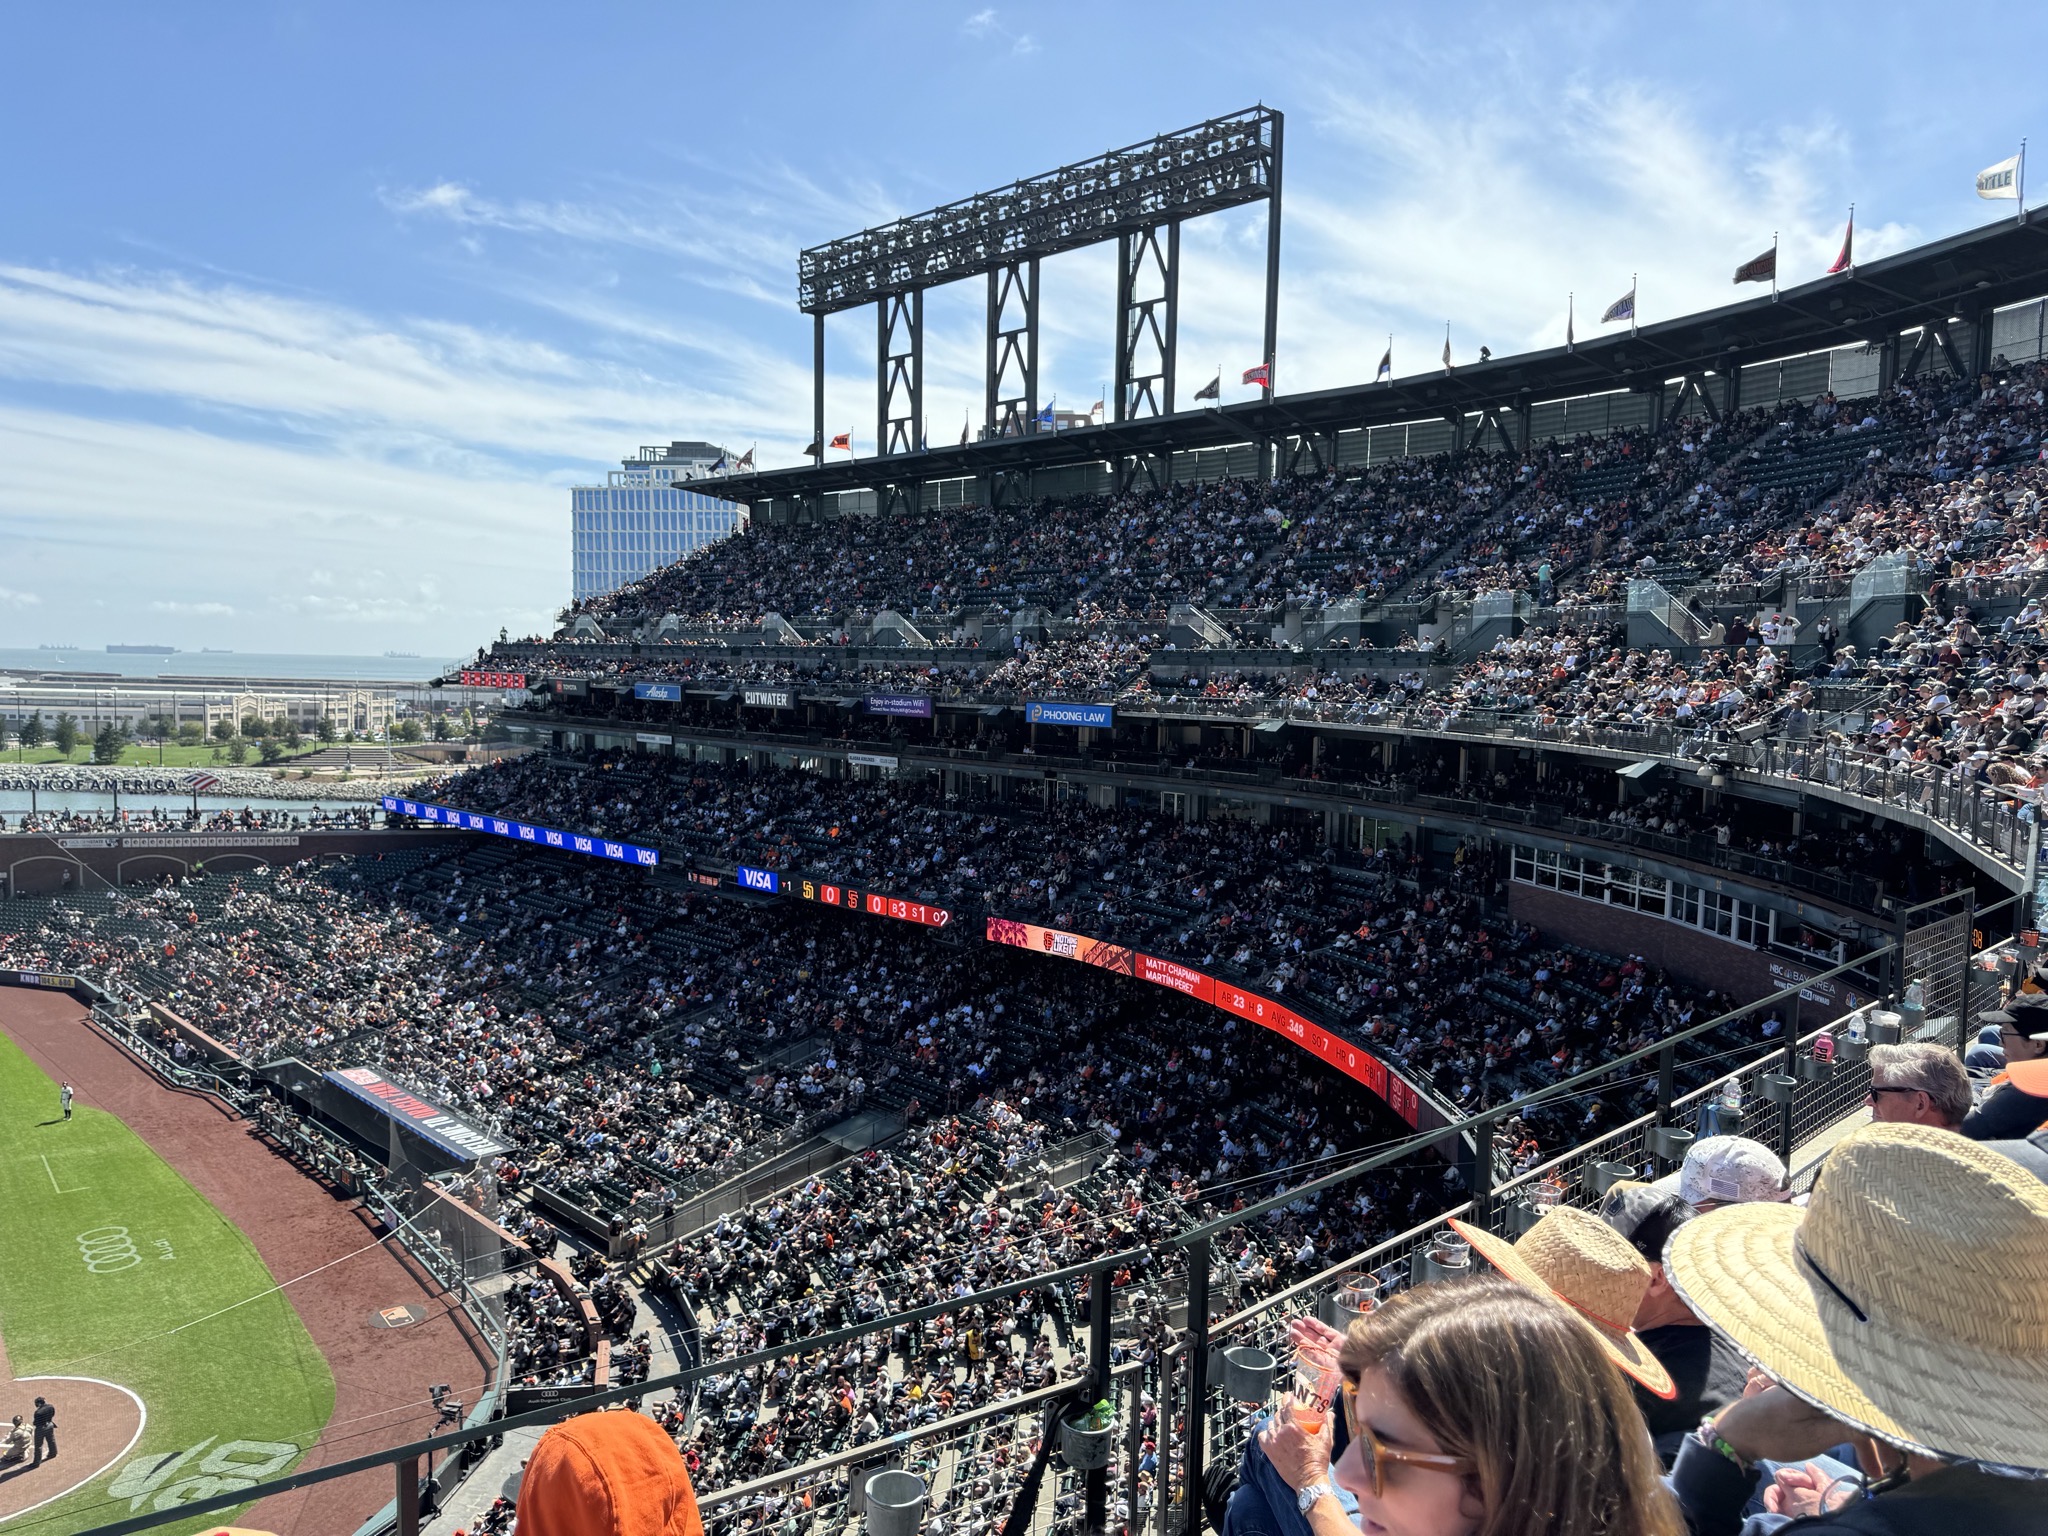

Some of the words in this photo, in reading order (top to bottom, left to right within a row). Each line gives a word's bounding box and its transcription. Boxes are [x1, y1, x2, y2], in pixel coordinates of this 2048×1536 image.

[646, 685, 667, 699] Alaska
[745, 691, 788, 706] CUTWATER
[870, 697, 883, 706] Enjoy
[884, 698, 912, 706] in-stadium
[1044, 710, 1082, 721] PHOONG
[1084, 712, 1105, 722] LAW
[2, 780, 54, 790] BANK
[61, 780, 85, 790] OF
[90, 780, 177, 790] AMERICA
[384, 798, 397, 810] VISA
[404, 802, 417, 815] VISA
[424, 806, 438, 820] VISA
[446, 811, 460, 824] VISA
[469, 815, 484, 830] VISA
[493, 820, 509, 834] VISA
[518, 826, 535, 840] VISA
[545, 831, 562, 846] VISA
[574, 836, 592, 852] VISA
[604, 842, 624, 858] VISA
[636, 848, 656, 864] VISA
[743, 868, 772, 890] VISA
[787, 881, 792, 892] 1
[826, 887, 834, 902] 0
[873, 897, 881, 912] 0
[1054, 933, 1078, 944] NOTHING
[1053, 942, 1068, 954] LIKE
[1068, 944, 1076, 956] IT
[20, 974, 40, 984] KNBR
[1146, 958, 1168, 972] MATT
[1168, 964, 1200, 984] CHAPMAN
[1770, 963, 1784, 976] NBC
[1793, 971, 1810, 982] BAY
[1146, 970, 1174, 986] MARTÍN
[1174, 978, 1194, 994] PÉREZ
[1801, 989, 1812, 999] AREA
[1812, 994, 1830, 1006] FORWARD
[1222, 991, 1232, 1004] AB
[1233, 994, 1244, 1008] 23
[1248, 1002, 1254, 1013] H
[1256, 1004, 1263, 1016] 8
[1271, 1012, 1286, 1028] AVG
[1286, 1018, 1304, 1038] .348
[1312, 1034, 1322, 1048] SO
[1323, 1038, 1328, 1052] 7
[1336, 1047, 1346, 1063] HR
[1348, 1054, 1355, 1068] 0
[1364, 1064, 1375, 1082] RBI
[362, 1081, 405, 1098] PARK
[1392, 1078, 1402, 1096] SD
[386, 1095, 440, 1119] ORACLE
[422, 1116, 455, 1128] TO
[436, 1127, 504, 1155] WELCOME
[151, 1238, 176, 1260] Audi
